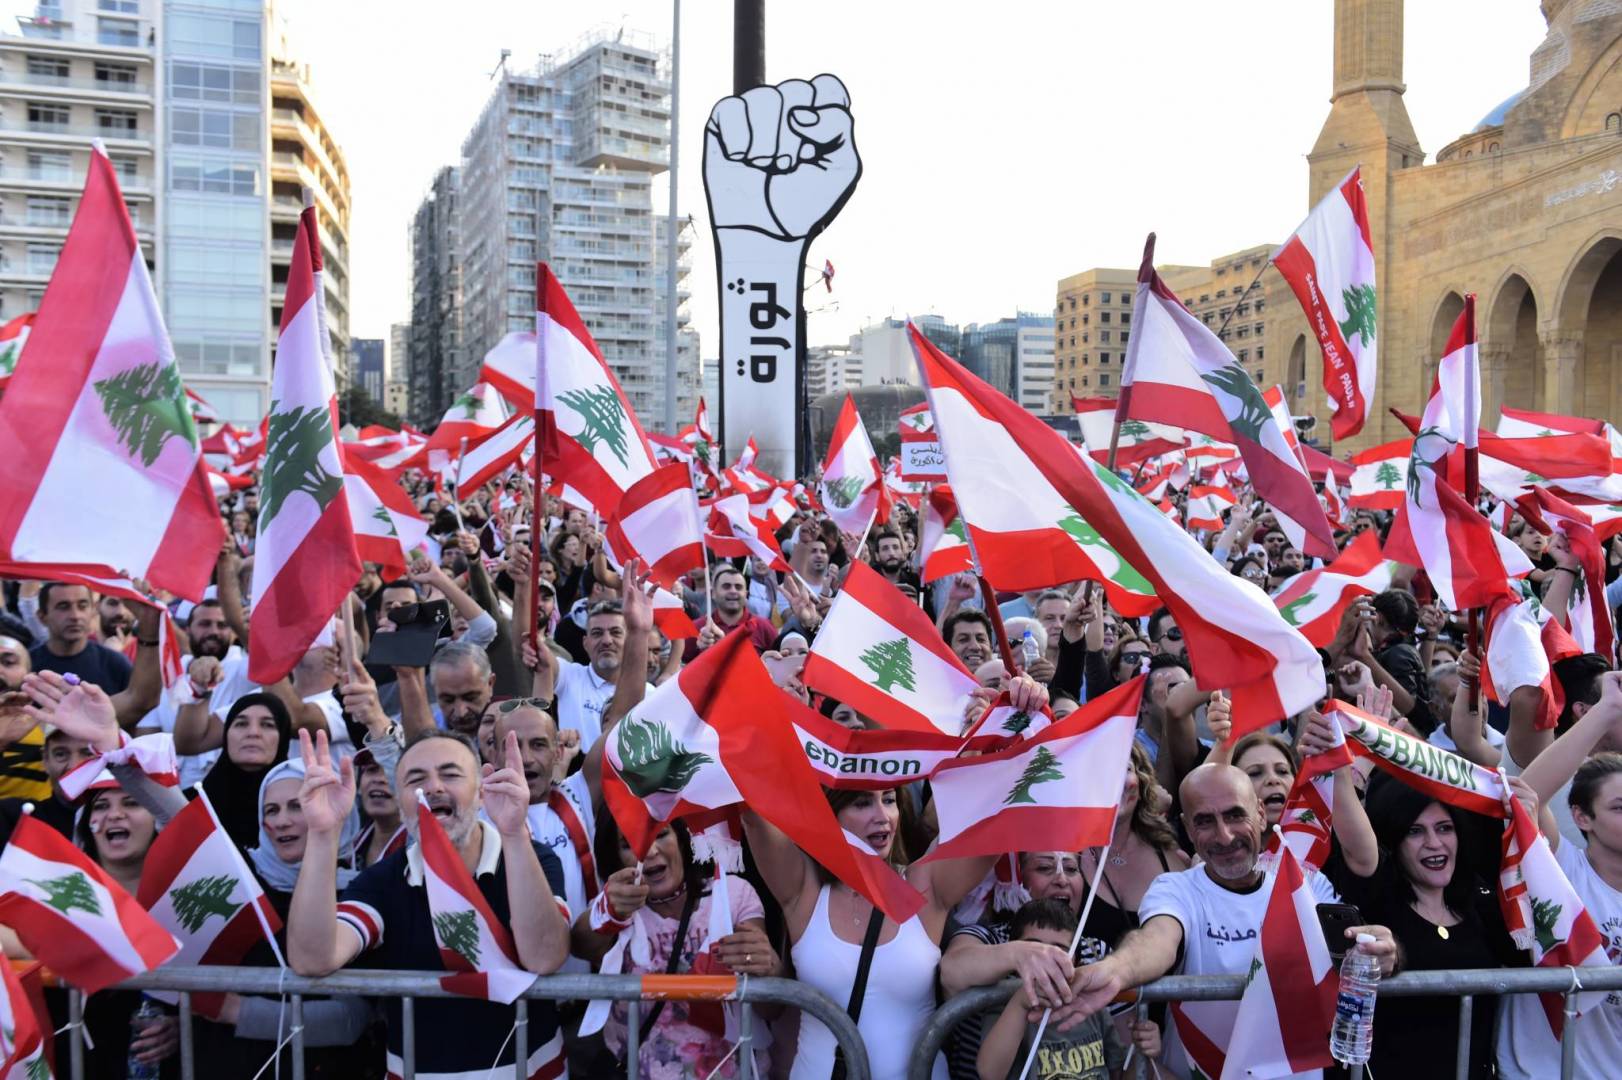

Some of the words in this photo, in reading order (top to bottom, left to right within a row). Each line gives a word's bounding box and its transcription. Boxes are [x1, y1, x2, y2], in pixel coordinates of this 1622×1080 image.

[727, 278, 792, 383] ثورة
[1305, 272, 1320, 306] SAINT
[1323, 340, 1345, 370] JEAN
[1340, 373, 1355, 401] PAUL
[805, 740, 921, 775] ebanon
[1350, 720, 1477, 791] LEBANON
[1206, 921, 1257, 946] مدنية
